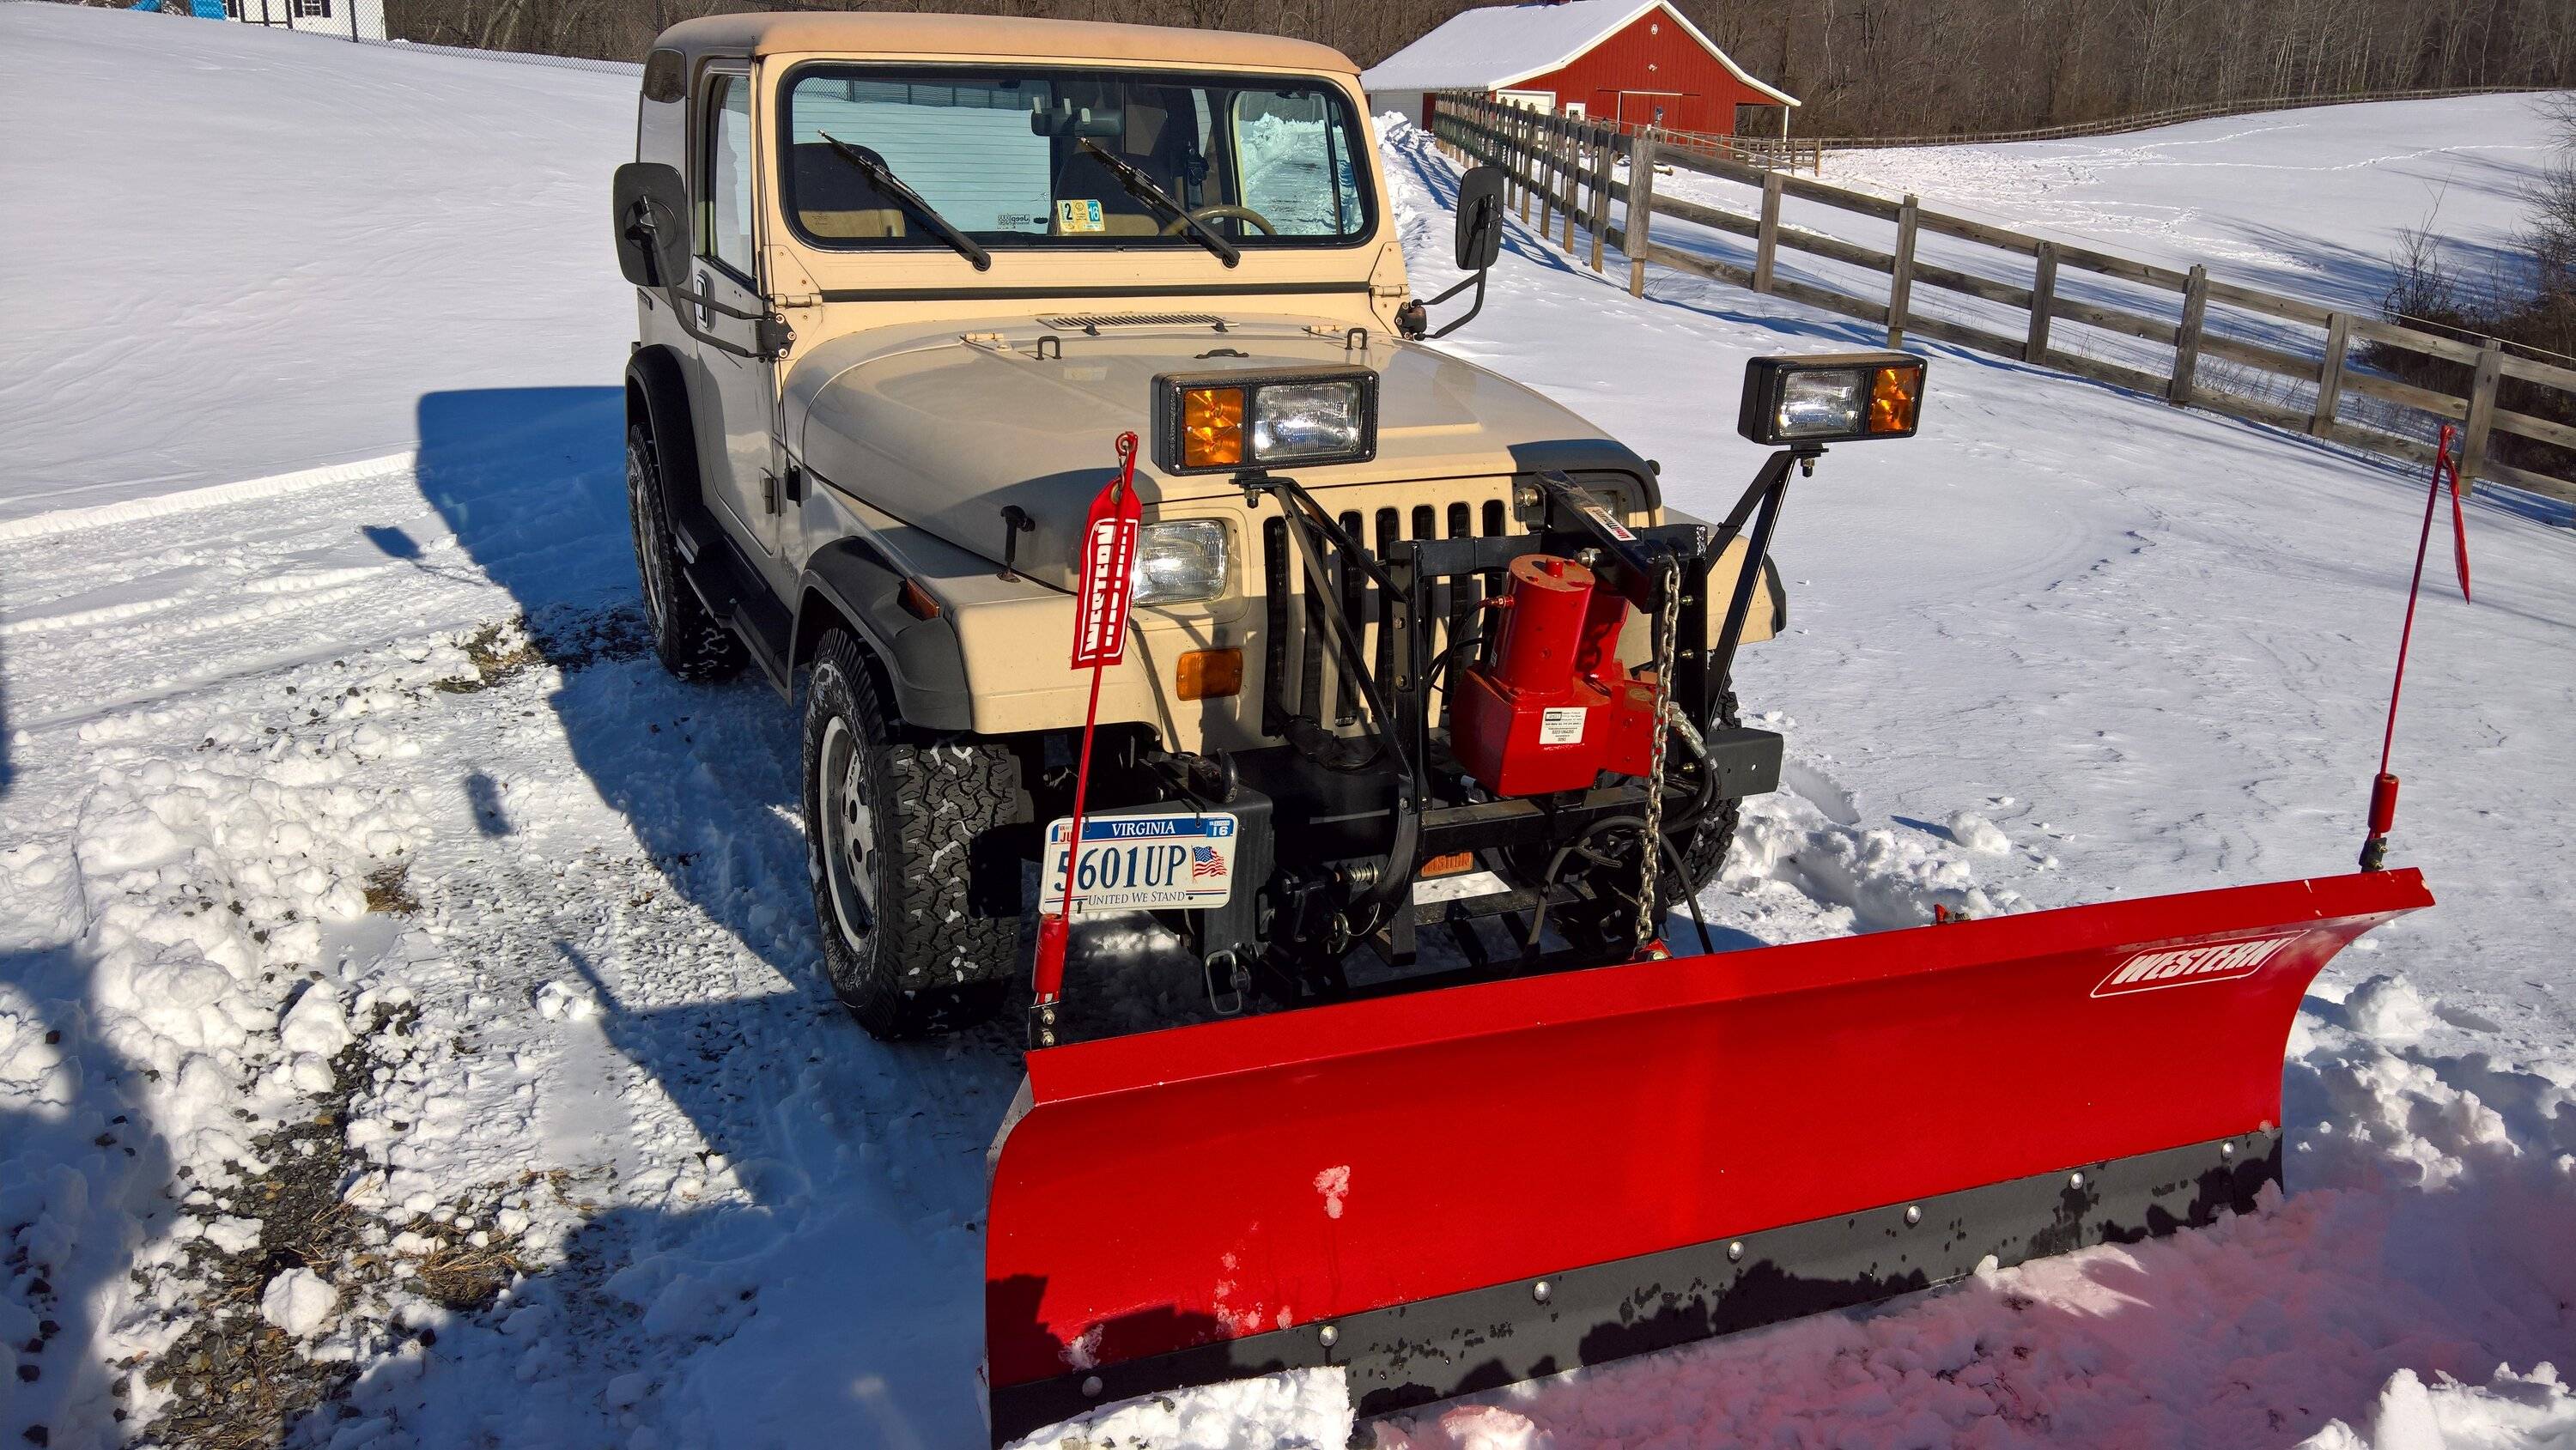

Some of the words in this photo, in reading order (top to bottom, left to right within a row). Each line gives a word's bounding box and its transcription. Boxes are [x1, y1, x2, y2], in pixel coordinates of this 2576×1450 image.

[1065, 203, 1072, 220] 2
[1112, 821, 1176, 837] VIRGINIA
[1212, 826, 1229, 836] 16
[1088, 893, 1128, 906] UNITED
[1151, 891, 1185, 901] STAND
[2111, 937, 2295, 986] WESTERN
